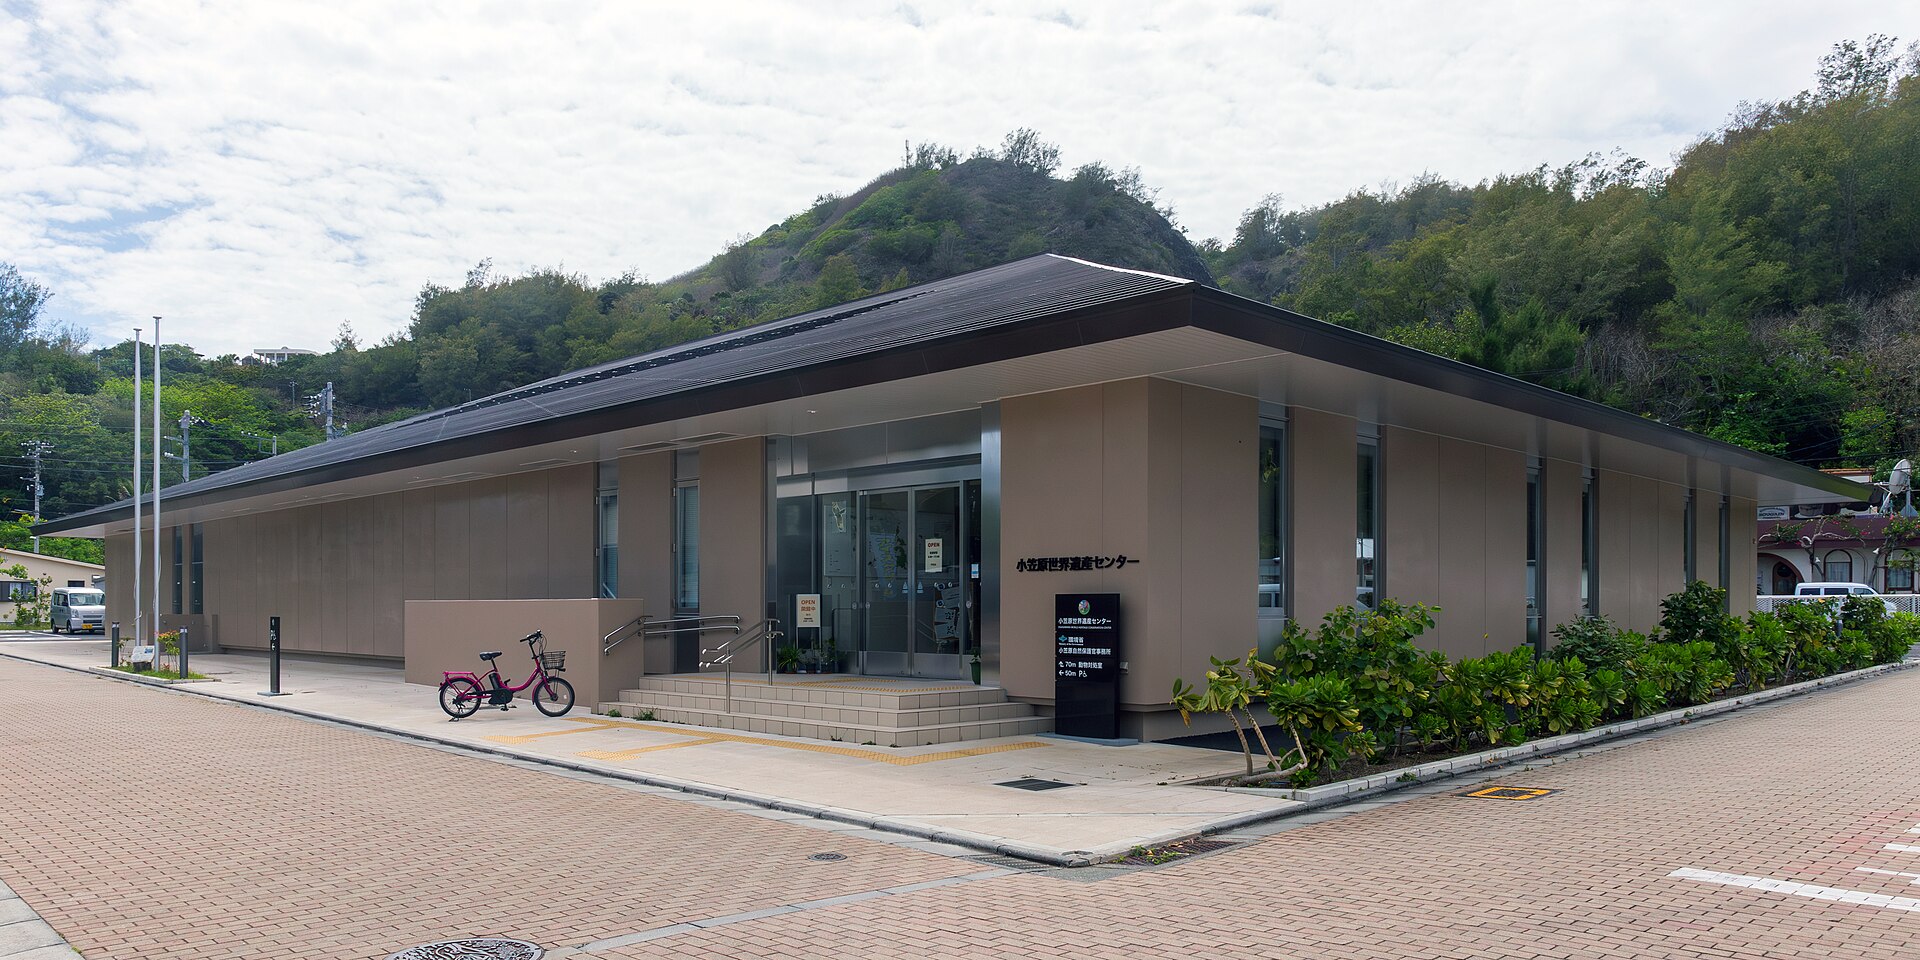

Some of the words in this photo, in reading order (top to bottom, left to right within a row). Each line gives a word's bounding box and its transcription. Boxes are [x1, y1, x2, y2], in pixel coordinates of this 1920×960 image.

[1016, 555, 1140, 572] 小笠原世界遺産センター
[1058, 617, 1112, 625] 小笠原世界遺産センター
